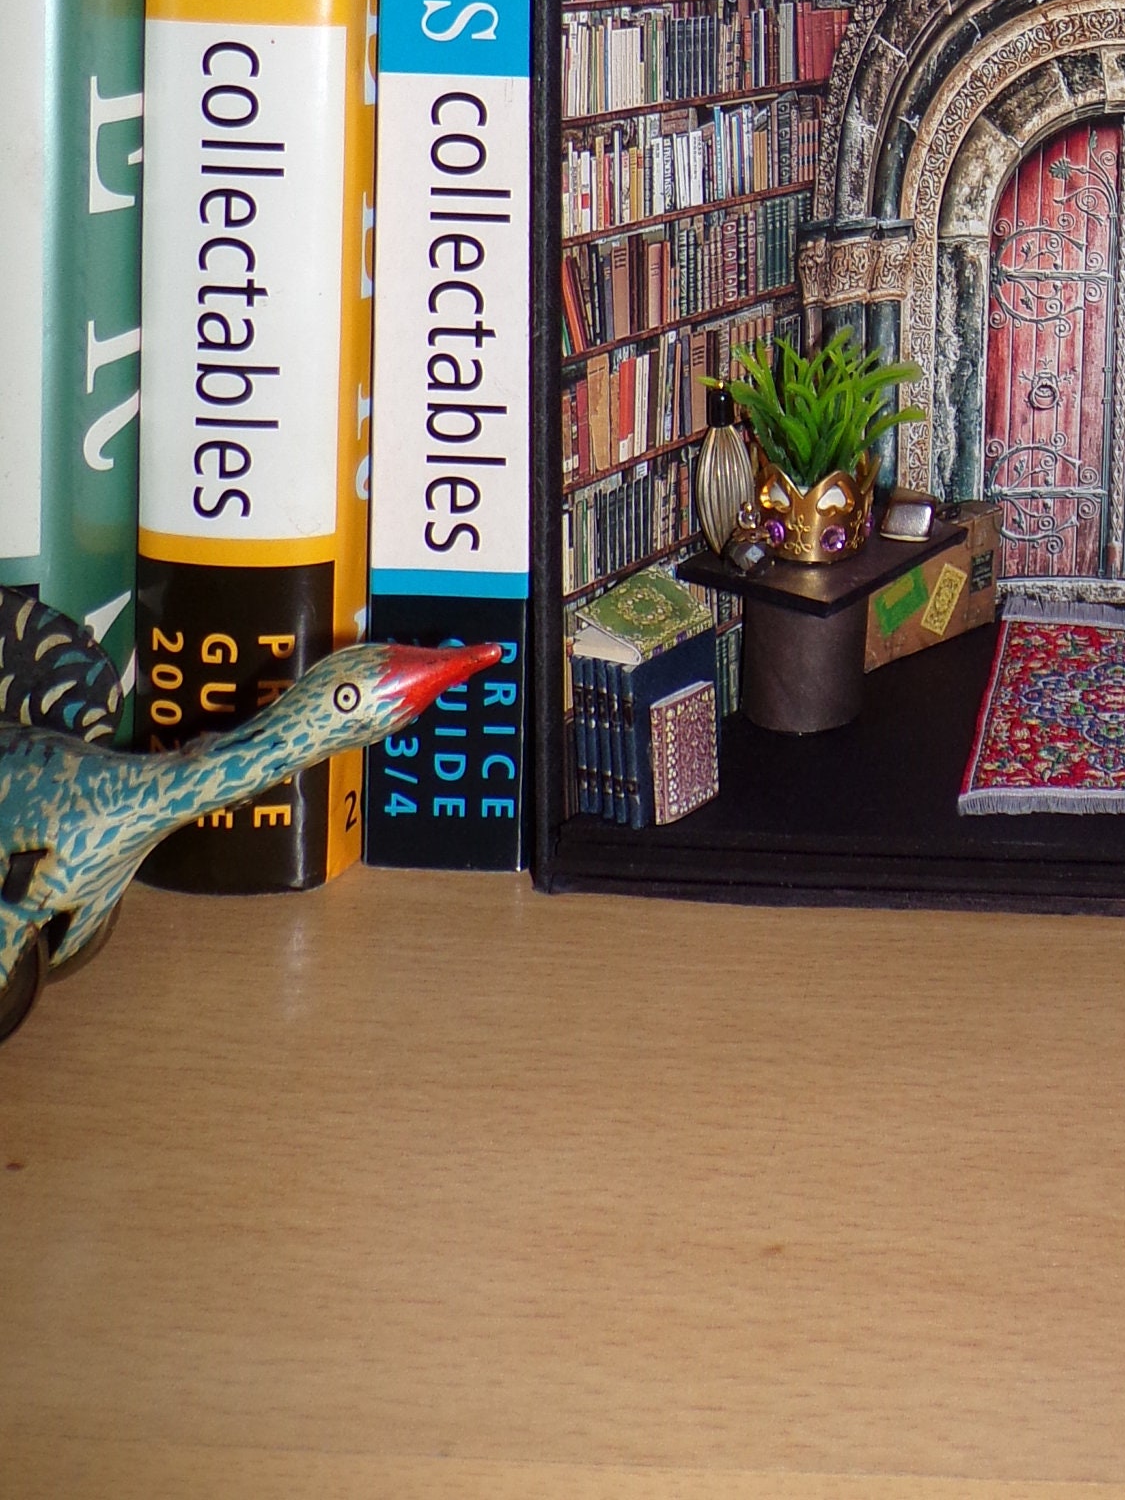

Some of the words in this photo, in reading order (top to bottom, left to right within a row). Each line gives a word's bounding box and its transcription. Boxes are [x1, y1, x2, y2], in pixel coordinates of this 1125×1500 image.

[193, 41, 287, 519] collectables
[424, 90, 512, 553] collectables
[433, 638, 468, 818] UIDE
